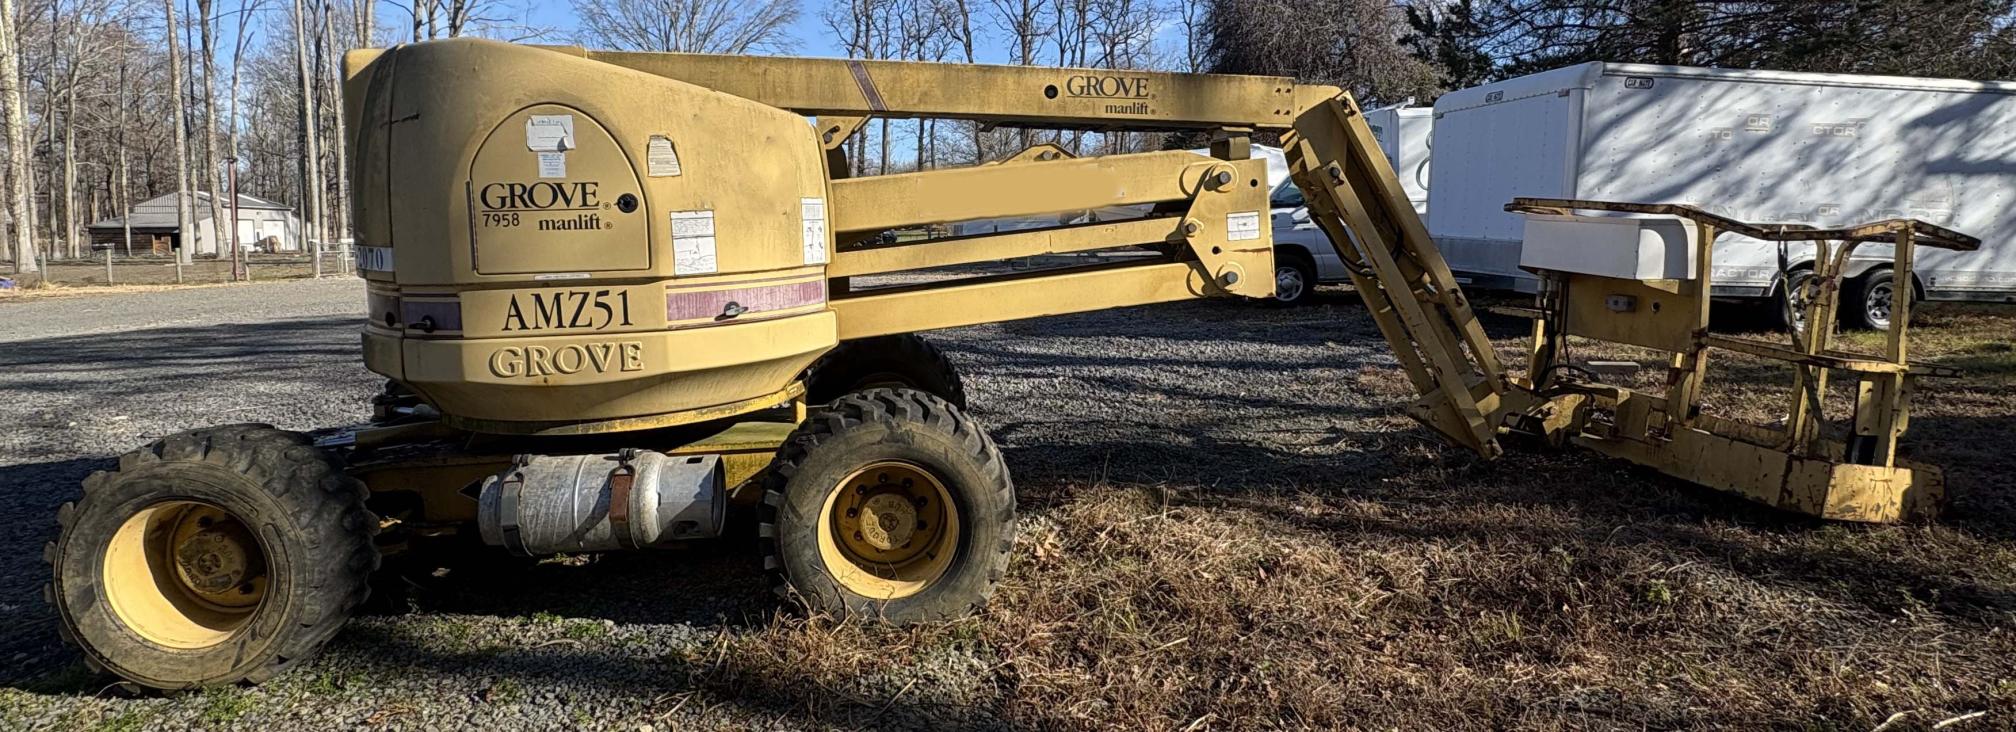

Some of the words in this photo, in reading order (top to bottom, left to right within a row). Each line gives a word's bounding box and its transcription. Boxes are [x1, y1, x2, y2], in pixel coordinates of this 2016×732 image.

[1066, 75, 1149, 98] GROVE
[1105, 101, 1149, 115] manlift
[480, 181, 600, 210] GROVE
[482, 212, 520, 228] 7958
[539, 213, 601, 231] manlift
[501, 289, 634, 331] AMZ51
[488, 340, 645, 378] GROVE
